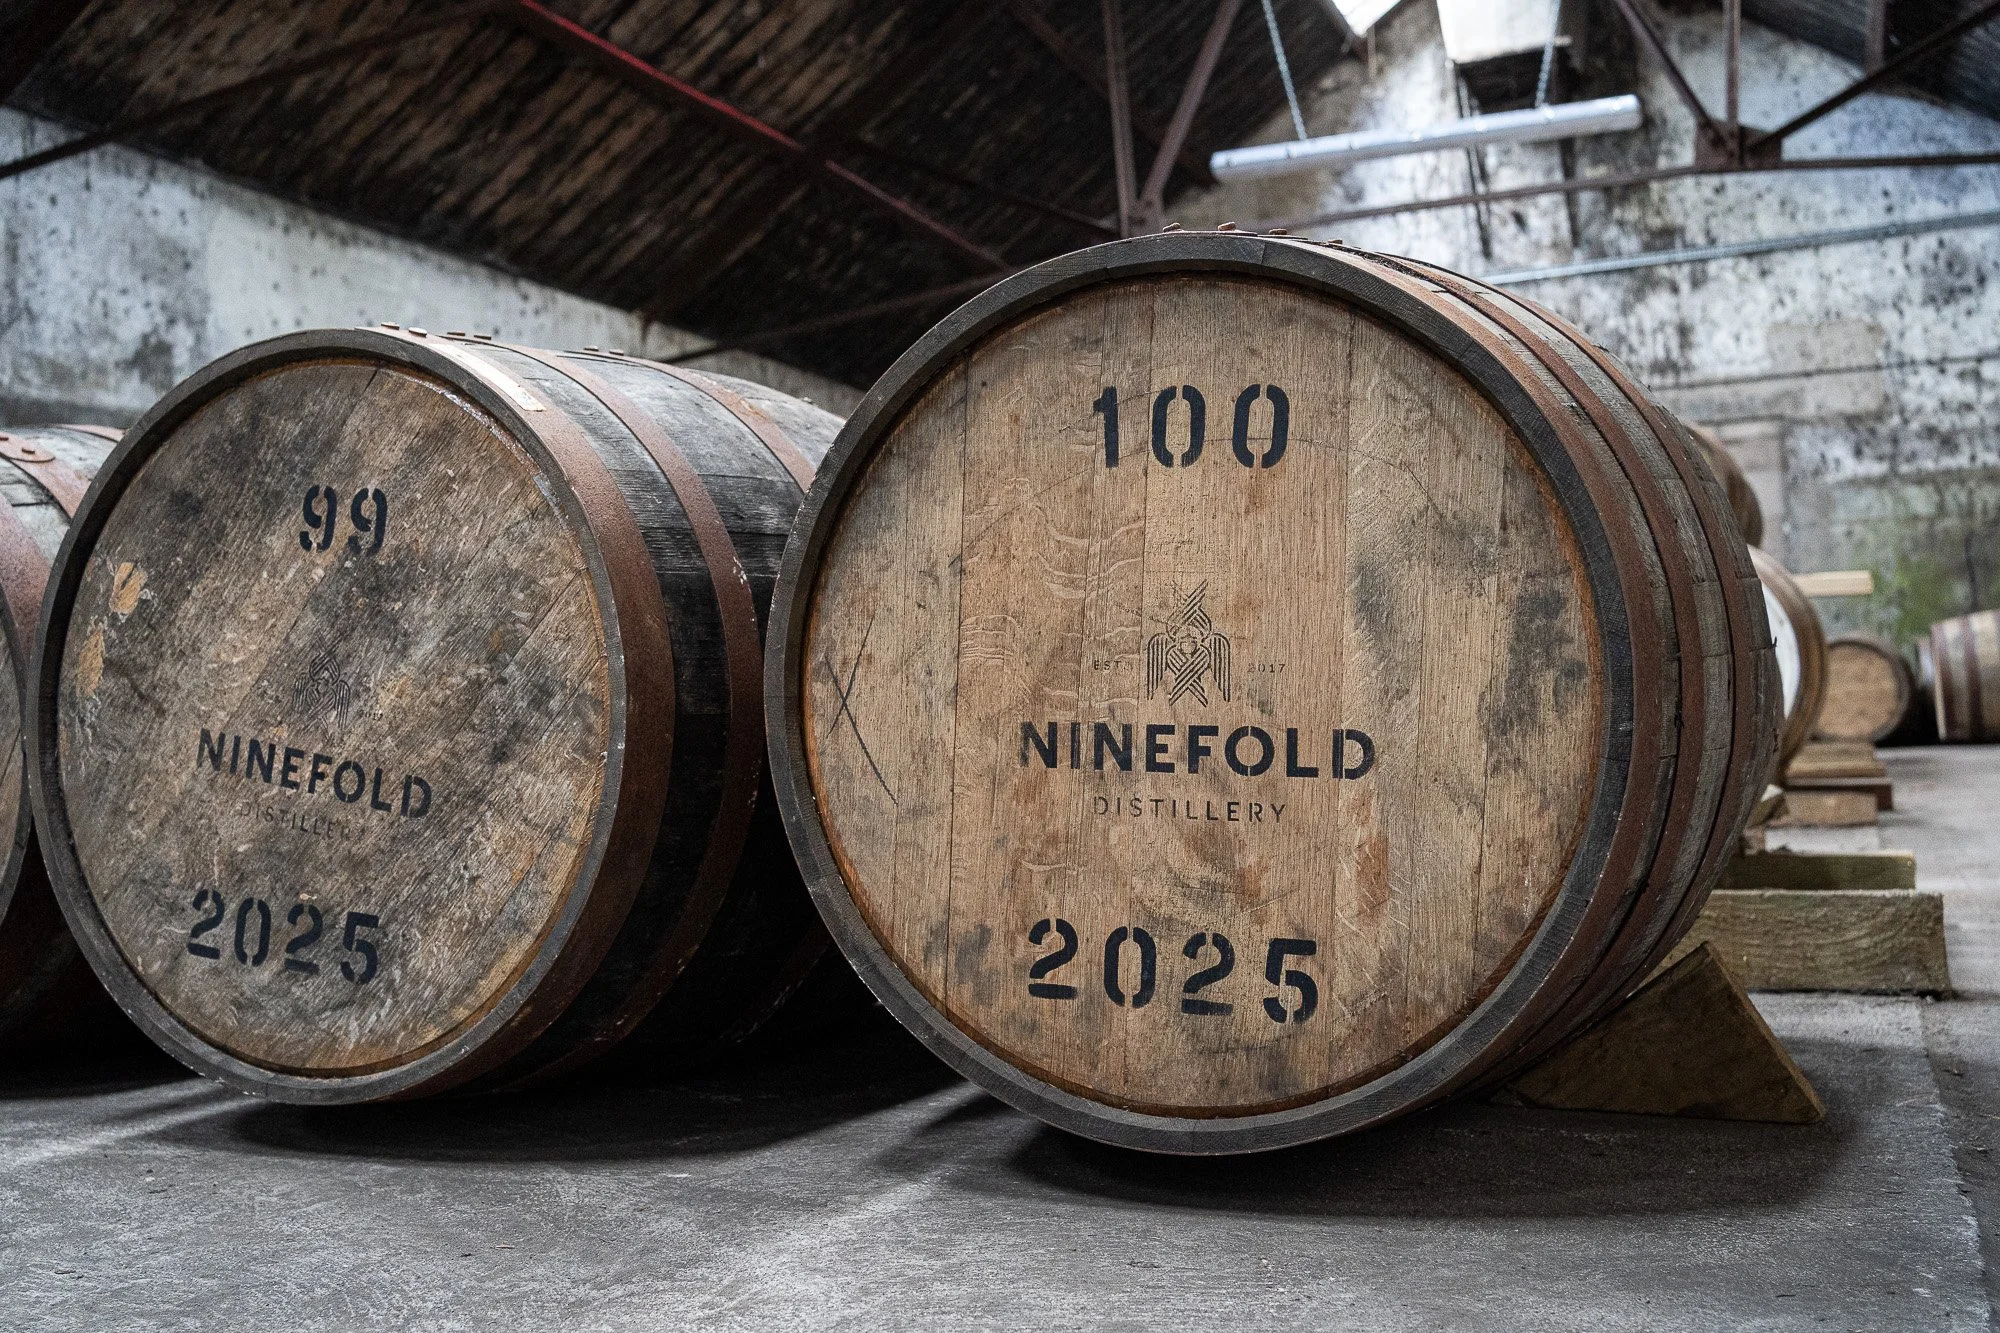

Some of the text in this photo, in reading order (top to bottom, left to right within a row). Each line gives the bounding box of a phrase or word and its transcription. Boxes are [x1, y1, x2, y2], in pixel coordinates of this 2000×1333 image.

[1093, 384, 1290, 469] 100
[300, 485, 388, 558] 99
[1247, 662, 1286, 673] 2017
[197, 727, 432, 819] NINEFOLD
[1019, 720, 1376, 780] NINEFOLD
[1093, 795, 1286, 824] DISTILLERY
[187, 889, 379, 985] 2025
[1028, 917, 1319, 1024] 2025
